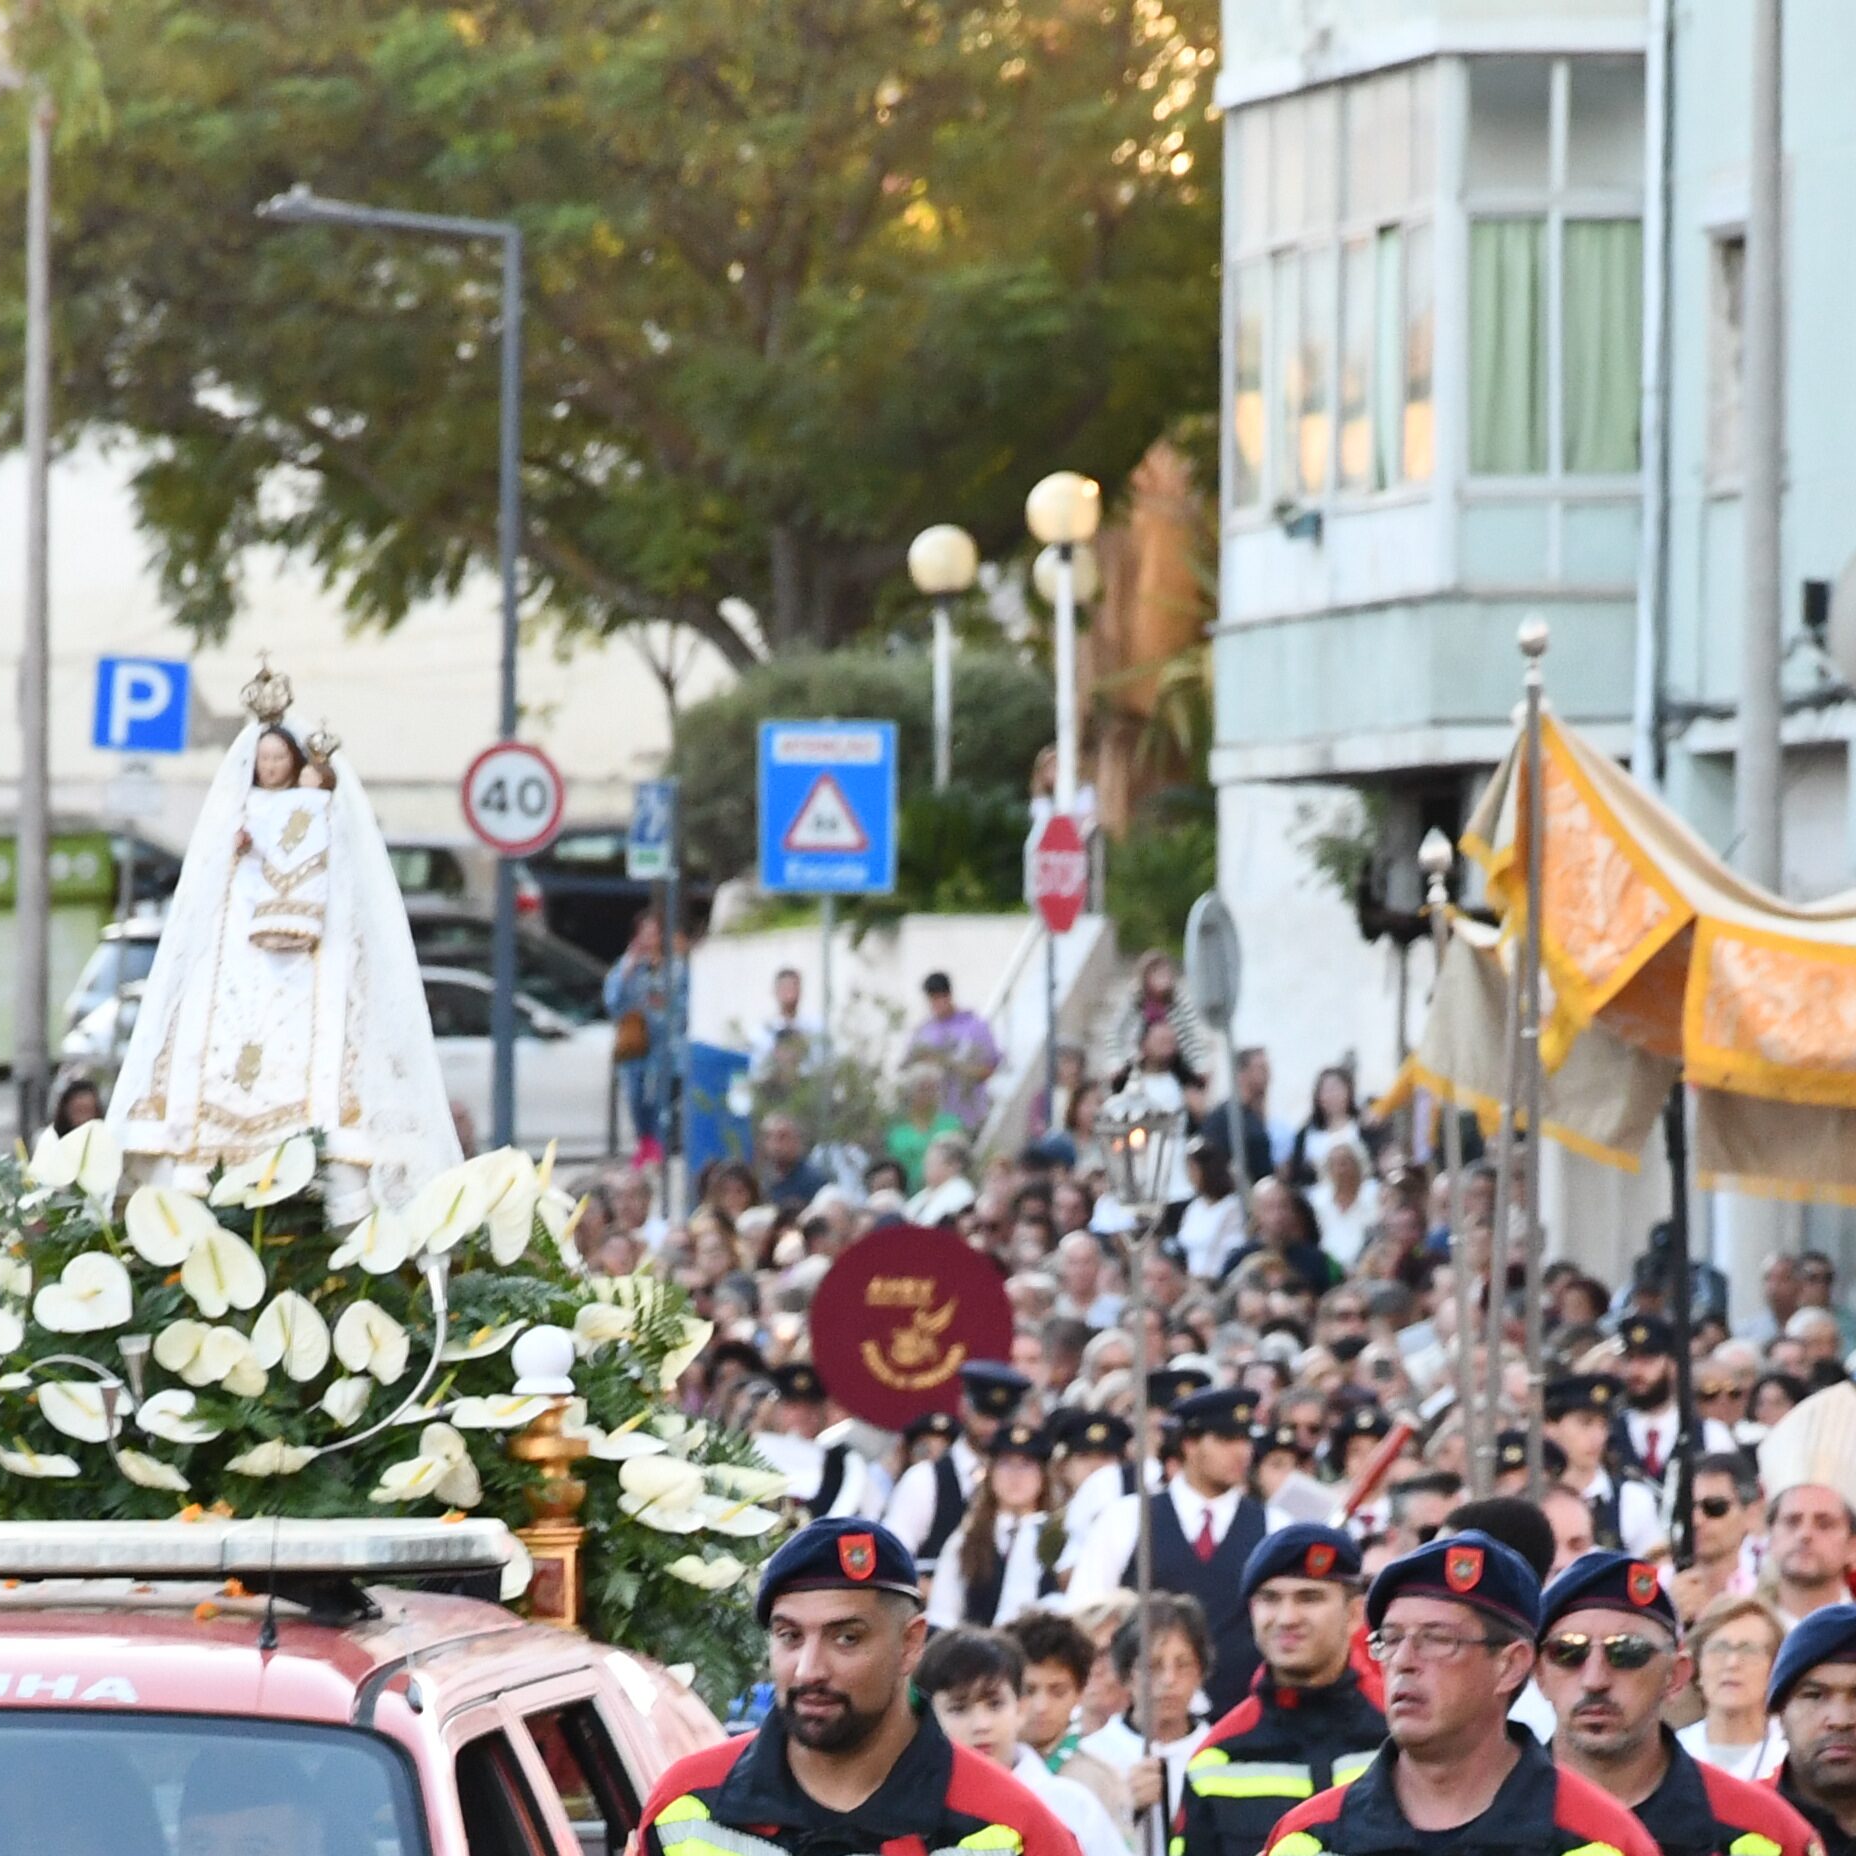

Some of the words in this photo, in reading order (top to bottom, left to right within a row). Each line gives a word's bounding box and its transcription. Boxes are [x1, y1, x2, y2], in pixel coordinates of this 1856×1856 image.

[108, 663, 172, 746] P
[479, 777, 547, 818] 40
[1034, 850, 1086, 898] STOP
